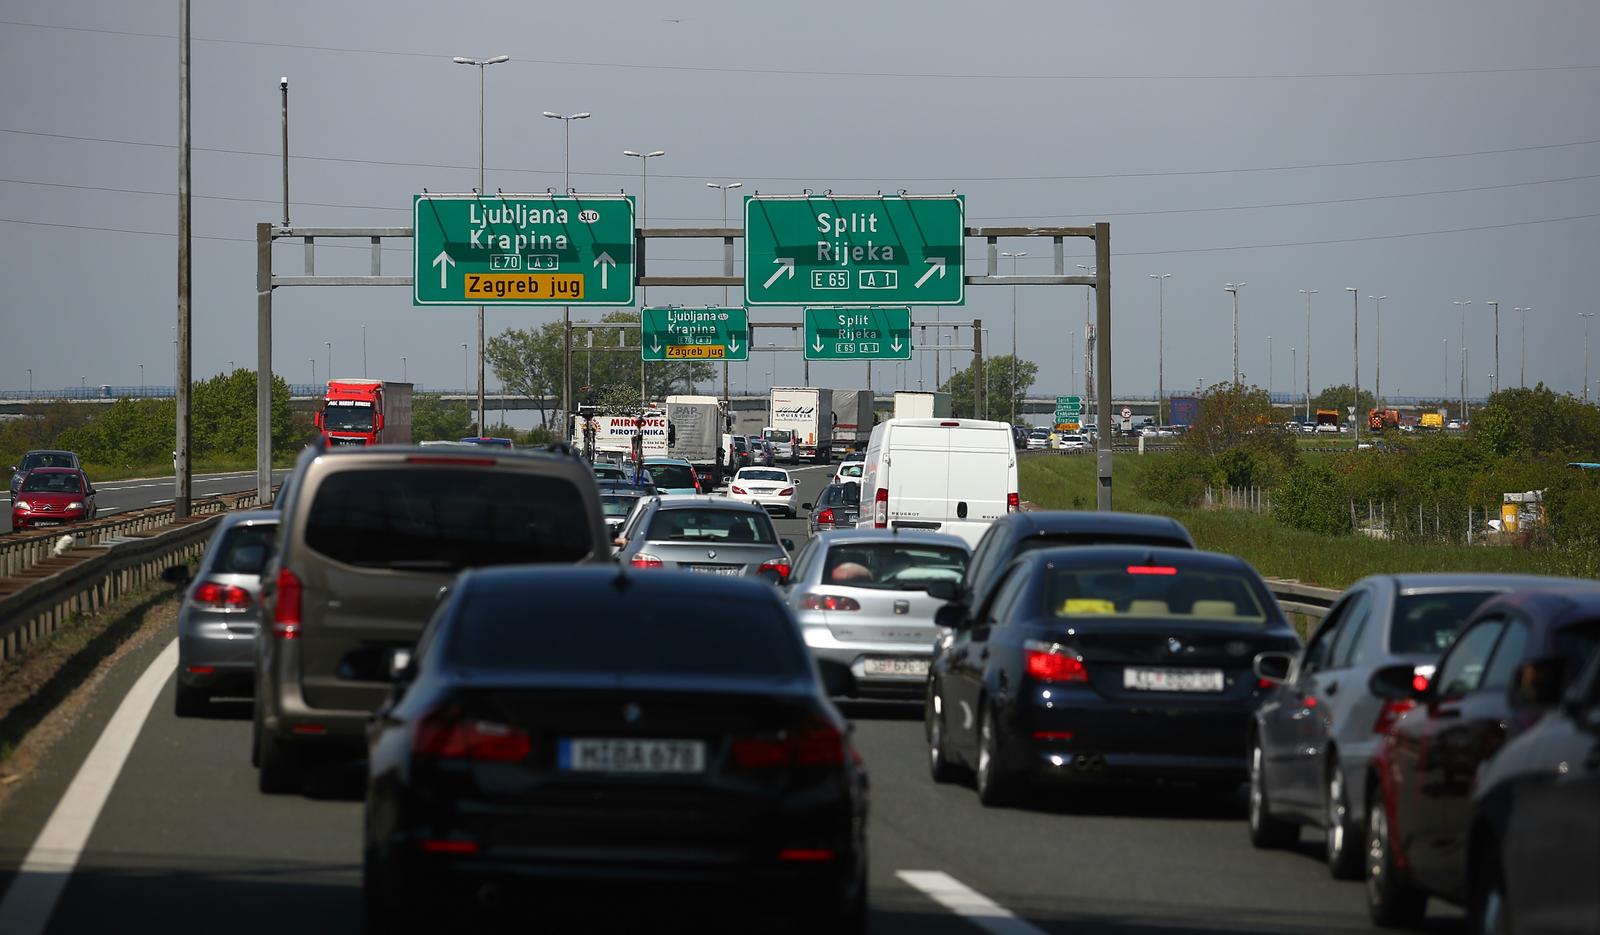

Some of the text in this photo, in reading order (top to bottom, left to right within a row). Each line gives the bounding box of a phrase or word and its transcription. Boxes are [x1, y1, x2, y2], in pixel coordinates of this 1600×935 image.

[470, 203, 598, 229] Ljubljana SLO
[817, 212, 878, 238] Split
[470, 229, 568, 254] Krapina
[817, 240, 894, 266] Rijeka
[494, 256, 517, 268] E 70
[534, 256, 554, 268] A 3
[469, 276, 580, 298] Zagreb jug
[815, 273, 846, 287] E 65
[867, 273, 890, 287] A 1
[668, 310, 716, 324] Ljubljana
[838, 314, 869, 327] Split
[668, 323, 716, 337] Krapina
[838, 328, 876, 341] Rijeka
[668, 346, 723, 358] Zagreb jug
